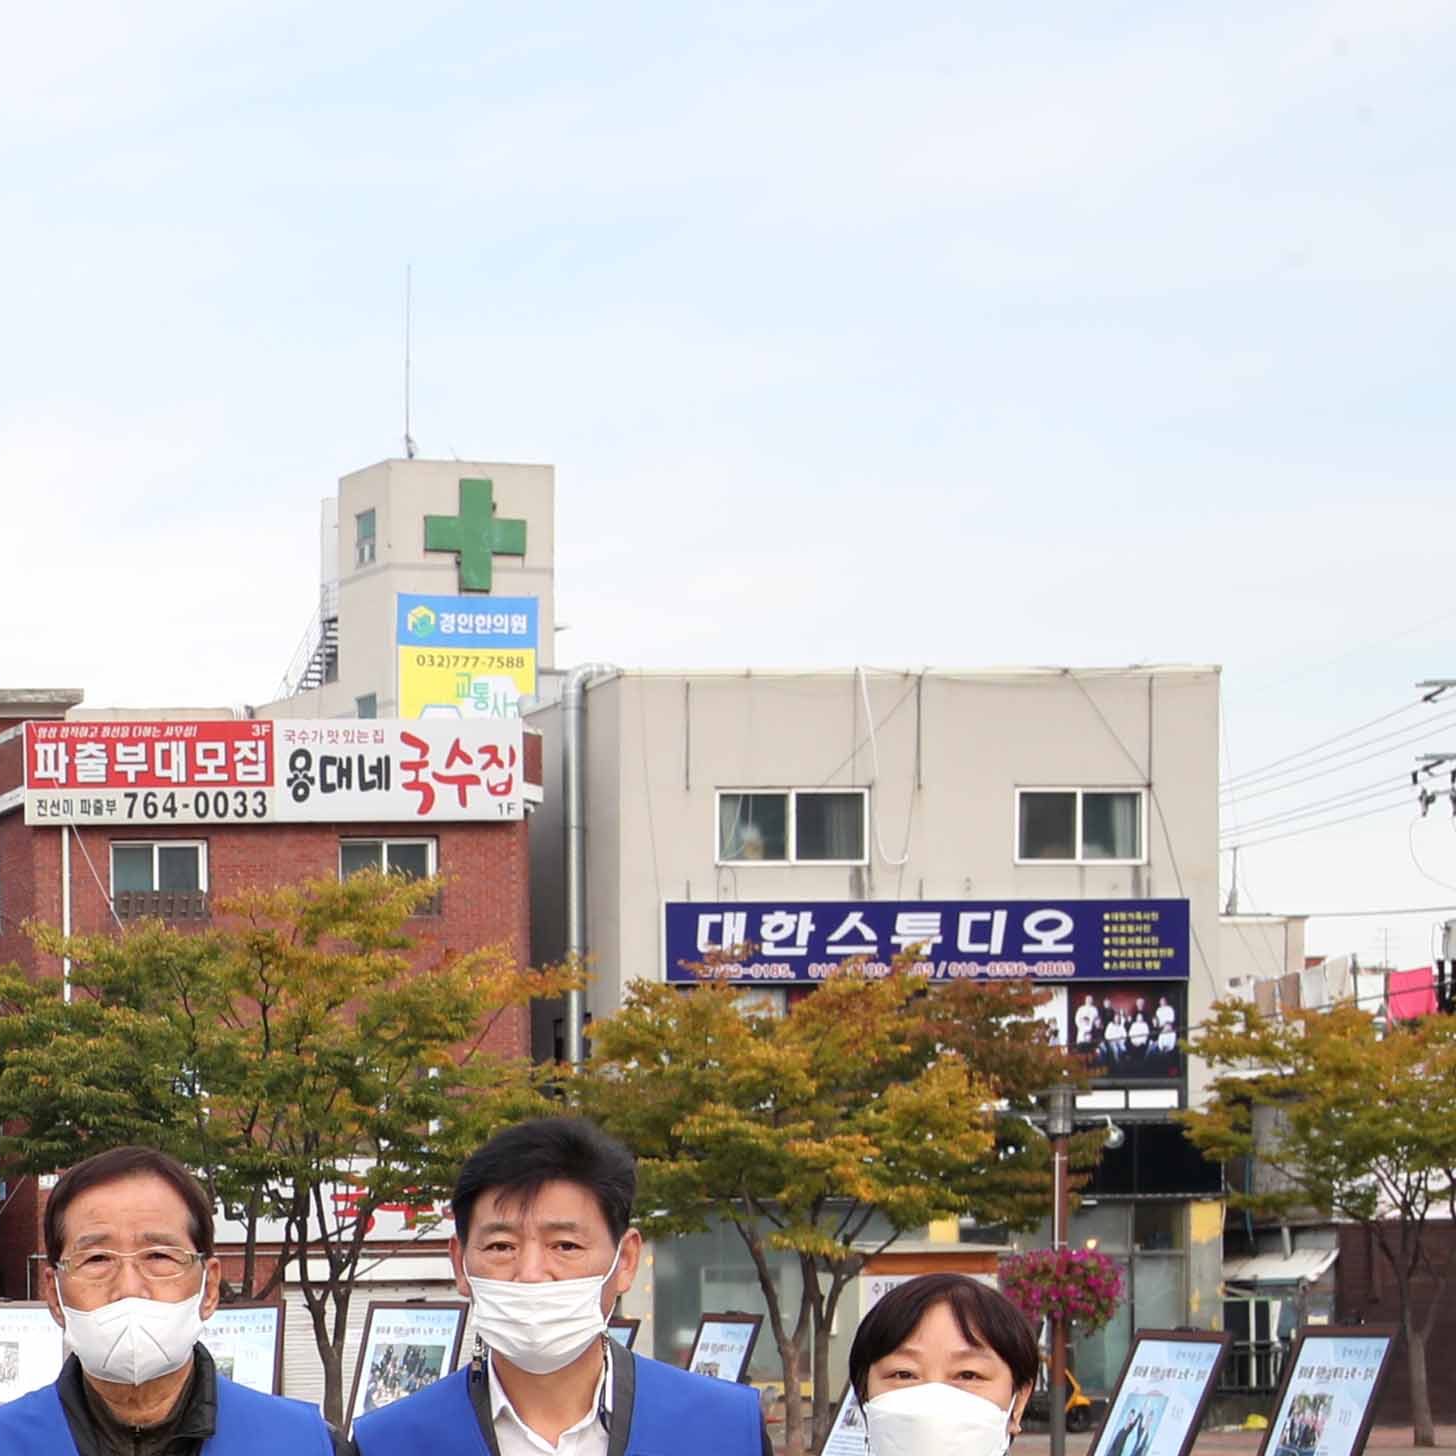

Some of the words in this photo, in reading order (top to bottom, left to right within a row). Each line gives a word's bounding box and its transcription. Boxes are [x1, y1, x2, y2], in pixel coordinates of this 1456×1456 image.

[416, 655, 525, 669] 032)777-7588
[251, 724, 271, 737] 3F
[283, 728, 324, 745] 국수가
[373, 728, 385, 745] 집
[286, 748, 391, 803] 용대네
[400, 730, 516, 816] 국수집
[36, 798, 74, 818] 진선미
[80, 798, 117, 817] 파출부
[124, 790, 268, 820] 764-0033
[498, 803, 516, 815] 1F
[697, 909, 1075, 956] 대한스튜디오
